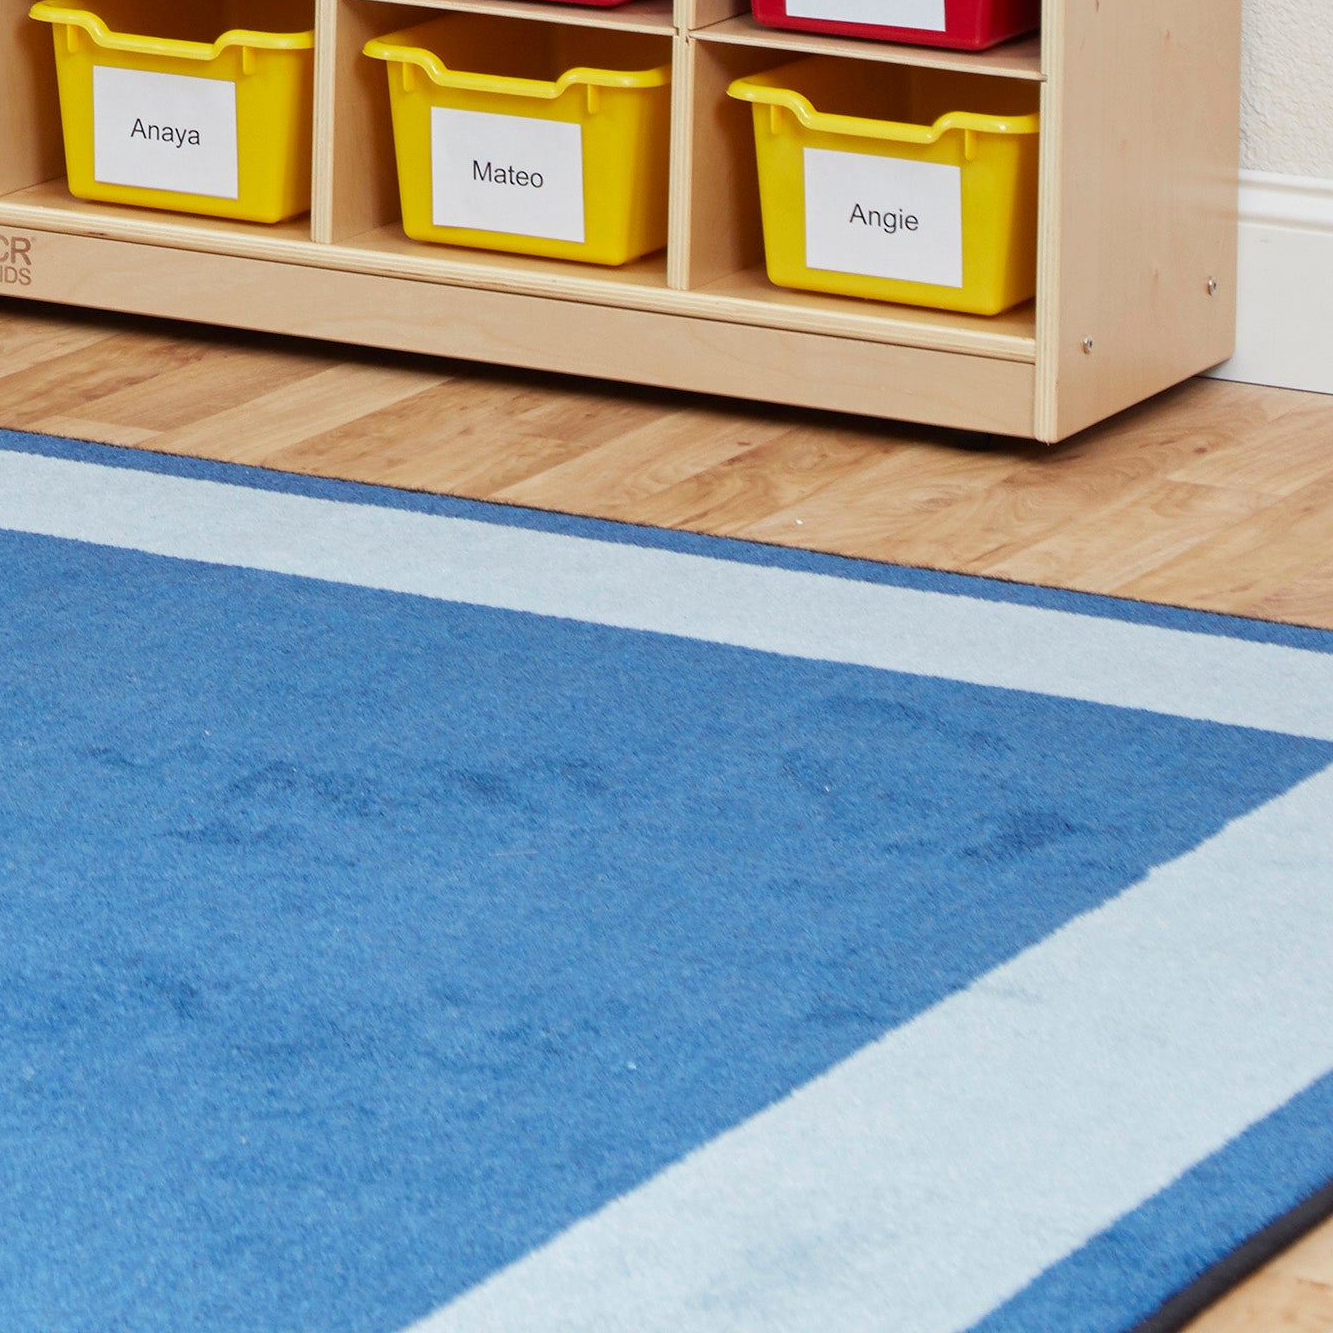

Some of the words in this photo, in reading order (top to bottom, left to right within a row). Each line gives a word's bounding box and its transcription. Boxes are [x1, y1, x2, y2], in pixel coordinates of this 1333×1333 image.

[130, 117, 201, 149] Anaya
[472, 159, 544, 189] Mateo
[849, 203, 919, 235] Angie
